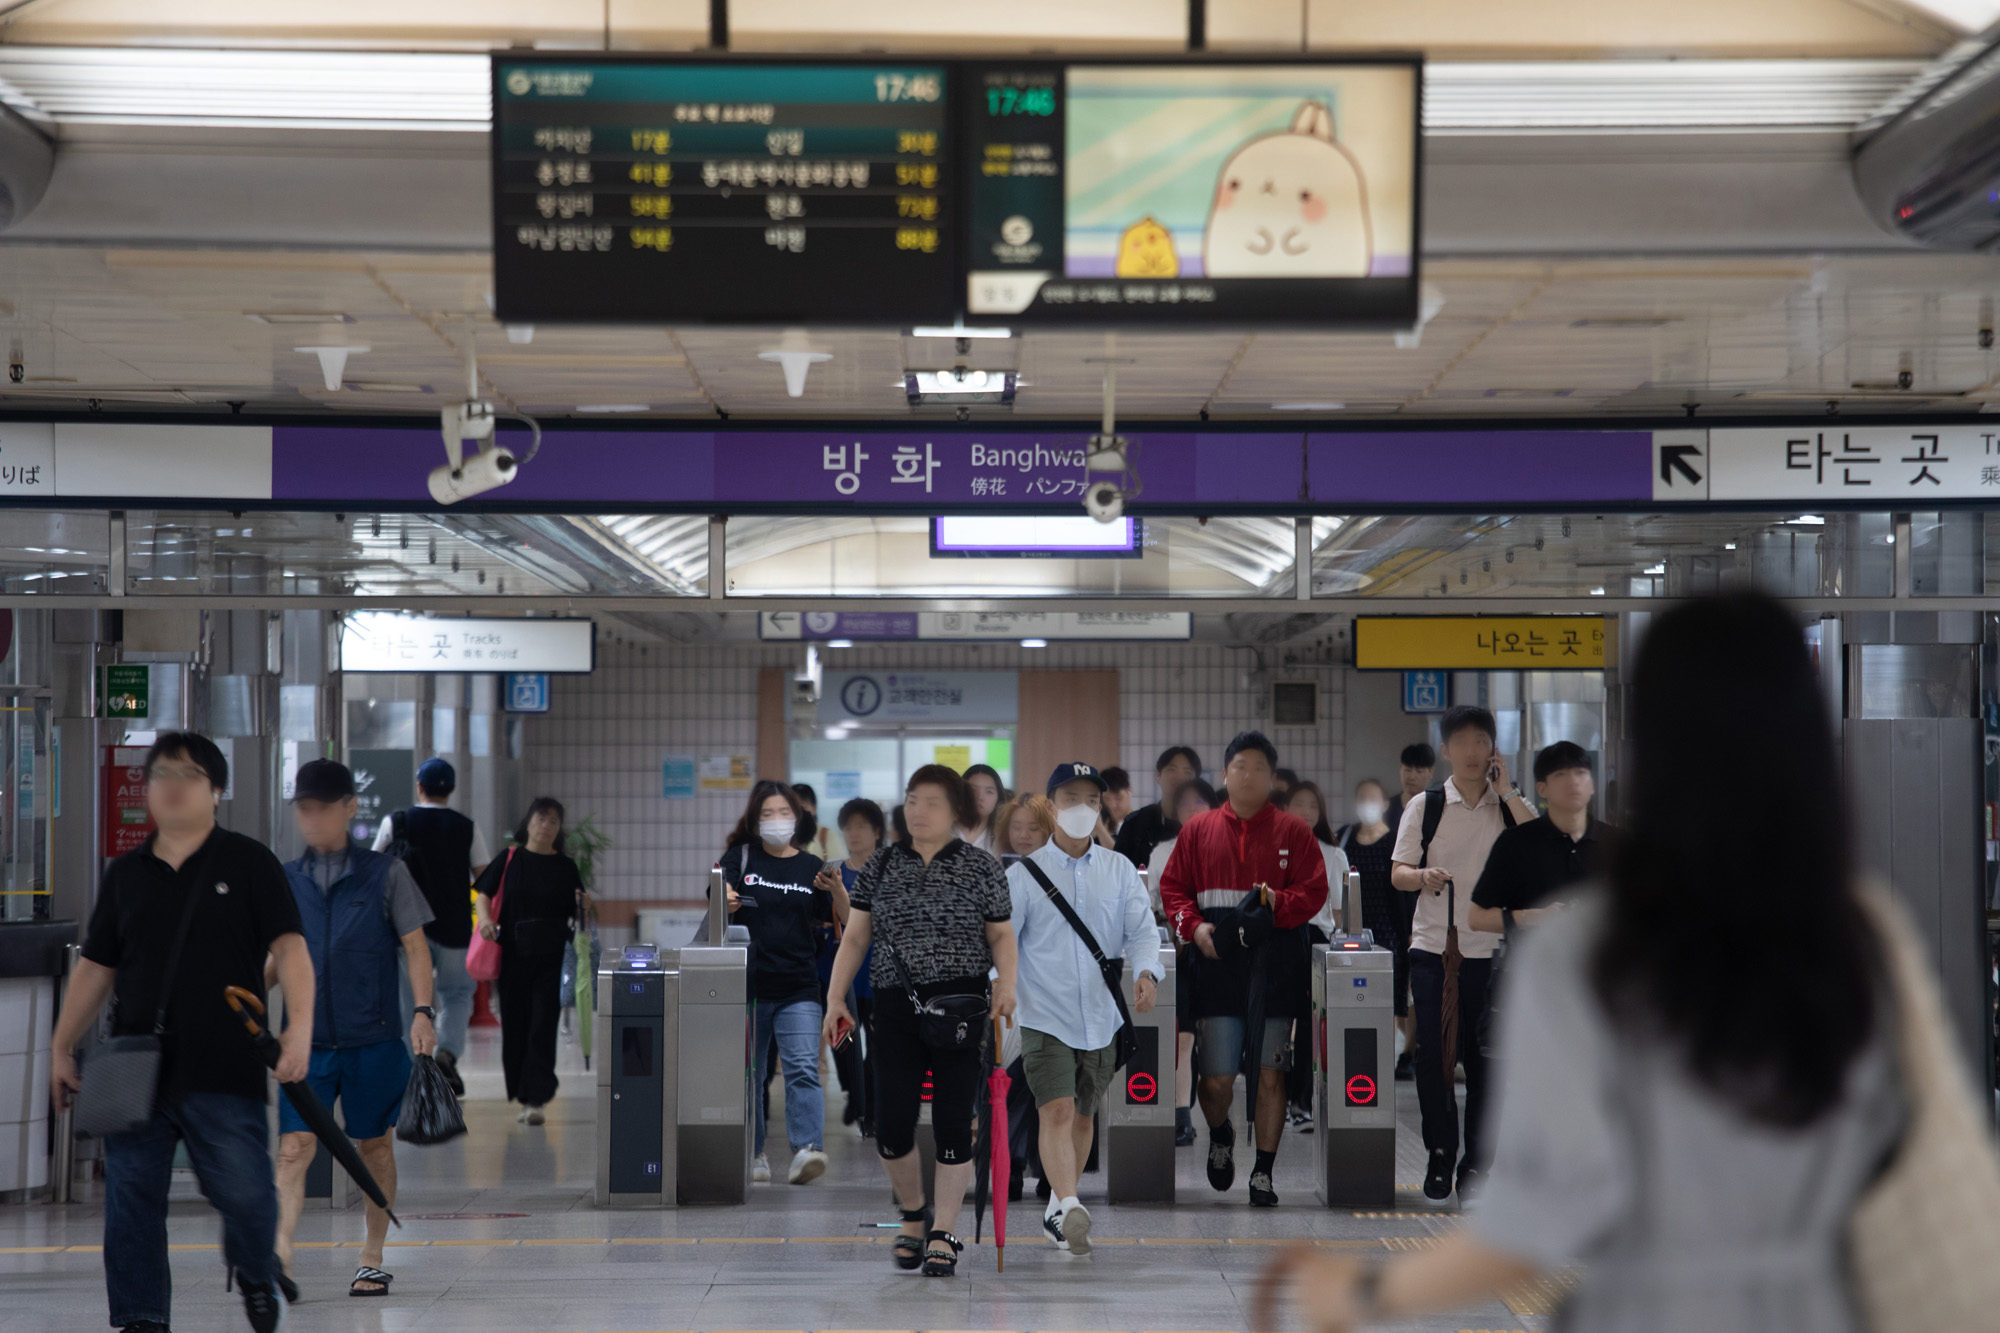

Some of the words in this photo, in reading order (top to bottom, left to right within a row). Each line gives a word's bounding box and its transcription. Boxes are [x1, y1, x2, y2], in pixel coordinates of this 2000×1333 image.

[875, 73, 940, 102] 17:46
[987, 87, 1055, 116] 17:46
[631, 129, 673, 155] 17분
[971, 444, 1085, 472] Banghwa
[1786, 433, 1881, 485] 타는
[1901, 434, 1949, 485] 곳
[971, 478, 1006, 496] 傍花
[429, 634, 452, 659] 곳
[462, 633, 501, 645] Tracks
[1478, 630, 1549, 656] 나오는
[1558, 630, 1582, 656] 곳
[124, 699, 147, 710] AED
[744, 874, 813, 895] Champion
[944, 1149, 956, 1159] H
[648, 1164, 657, 1173] E1
